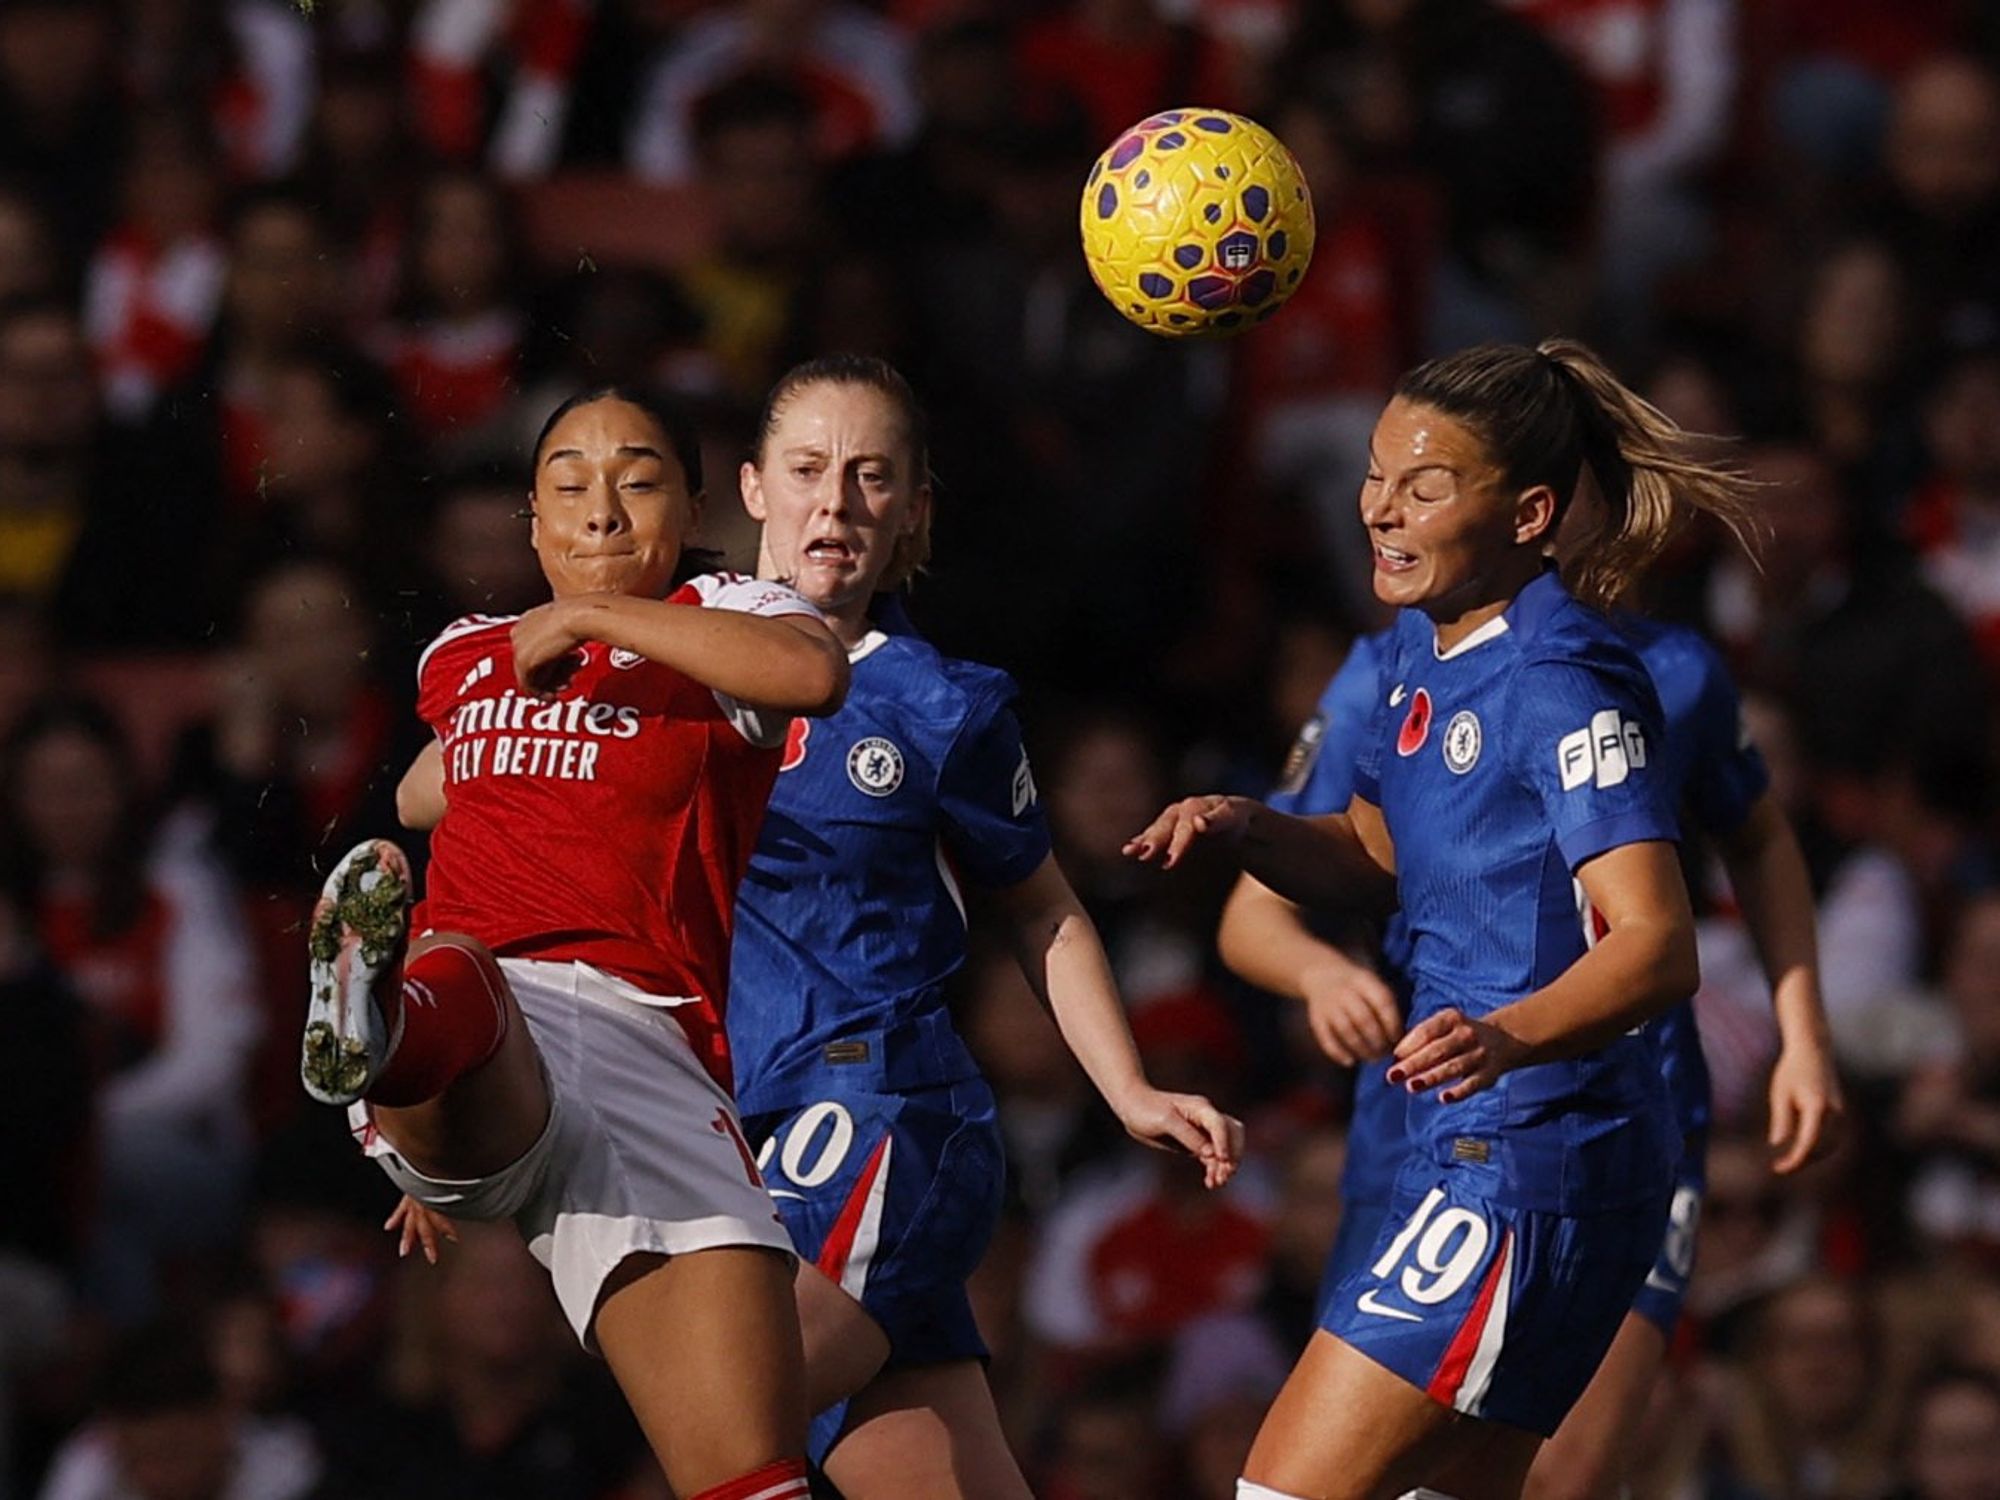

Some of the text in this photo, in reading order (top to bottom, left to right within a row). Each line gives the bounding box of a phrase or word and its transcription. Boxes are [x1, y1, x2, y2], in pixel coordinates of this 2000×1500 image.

[453, 736, 599, 784] FLY BETTER
[757, 1102, 853, 1187] 0
[1372, 1189, 1488, 1304] 19
